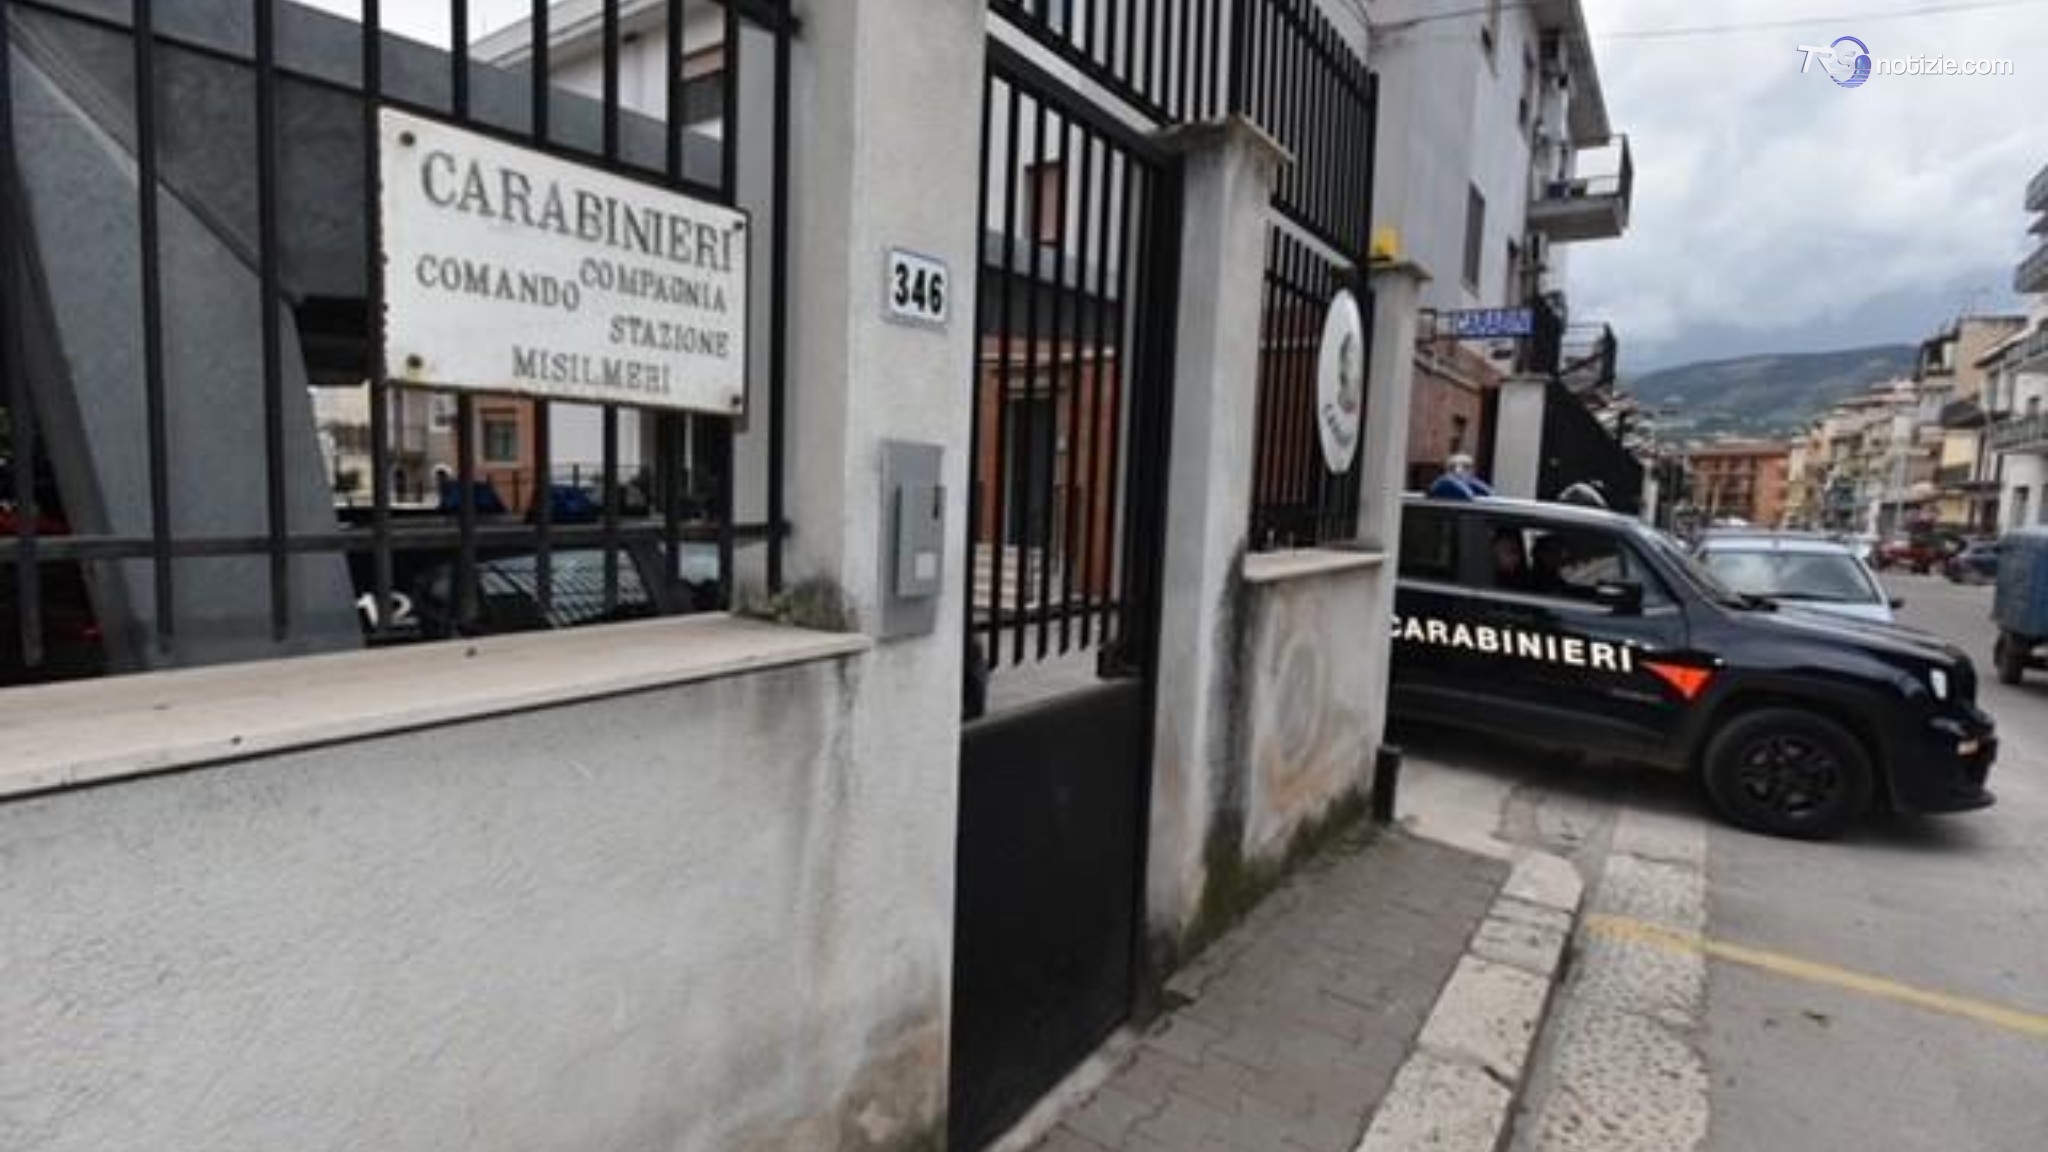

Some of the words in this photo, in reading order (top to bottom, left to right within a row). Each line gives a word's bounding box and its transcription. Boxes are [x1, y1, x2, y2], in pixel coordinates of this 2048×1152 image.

[421, 151, 733, 272] CARABINIERI
[416, 254, 580, 312] COMANDO
[579, 258, 727, 313] COMPAGNIA
[895, 262, 943, 315] 346
[609, 315, 730, 358] STAZIONE
[511, 345, 671, 394] MISILMERI
